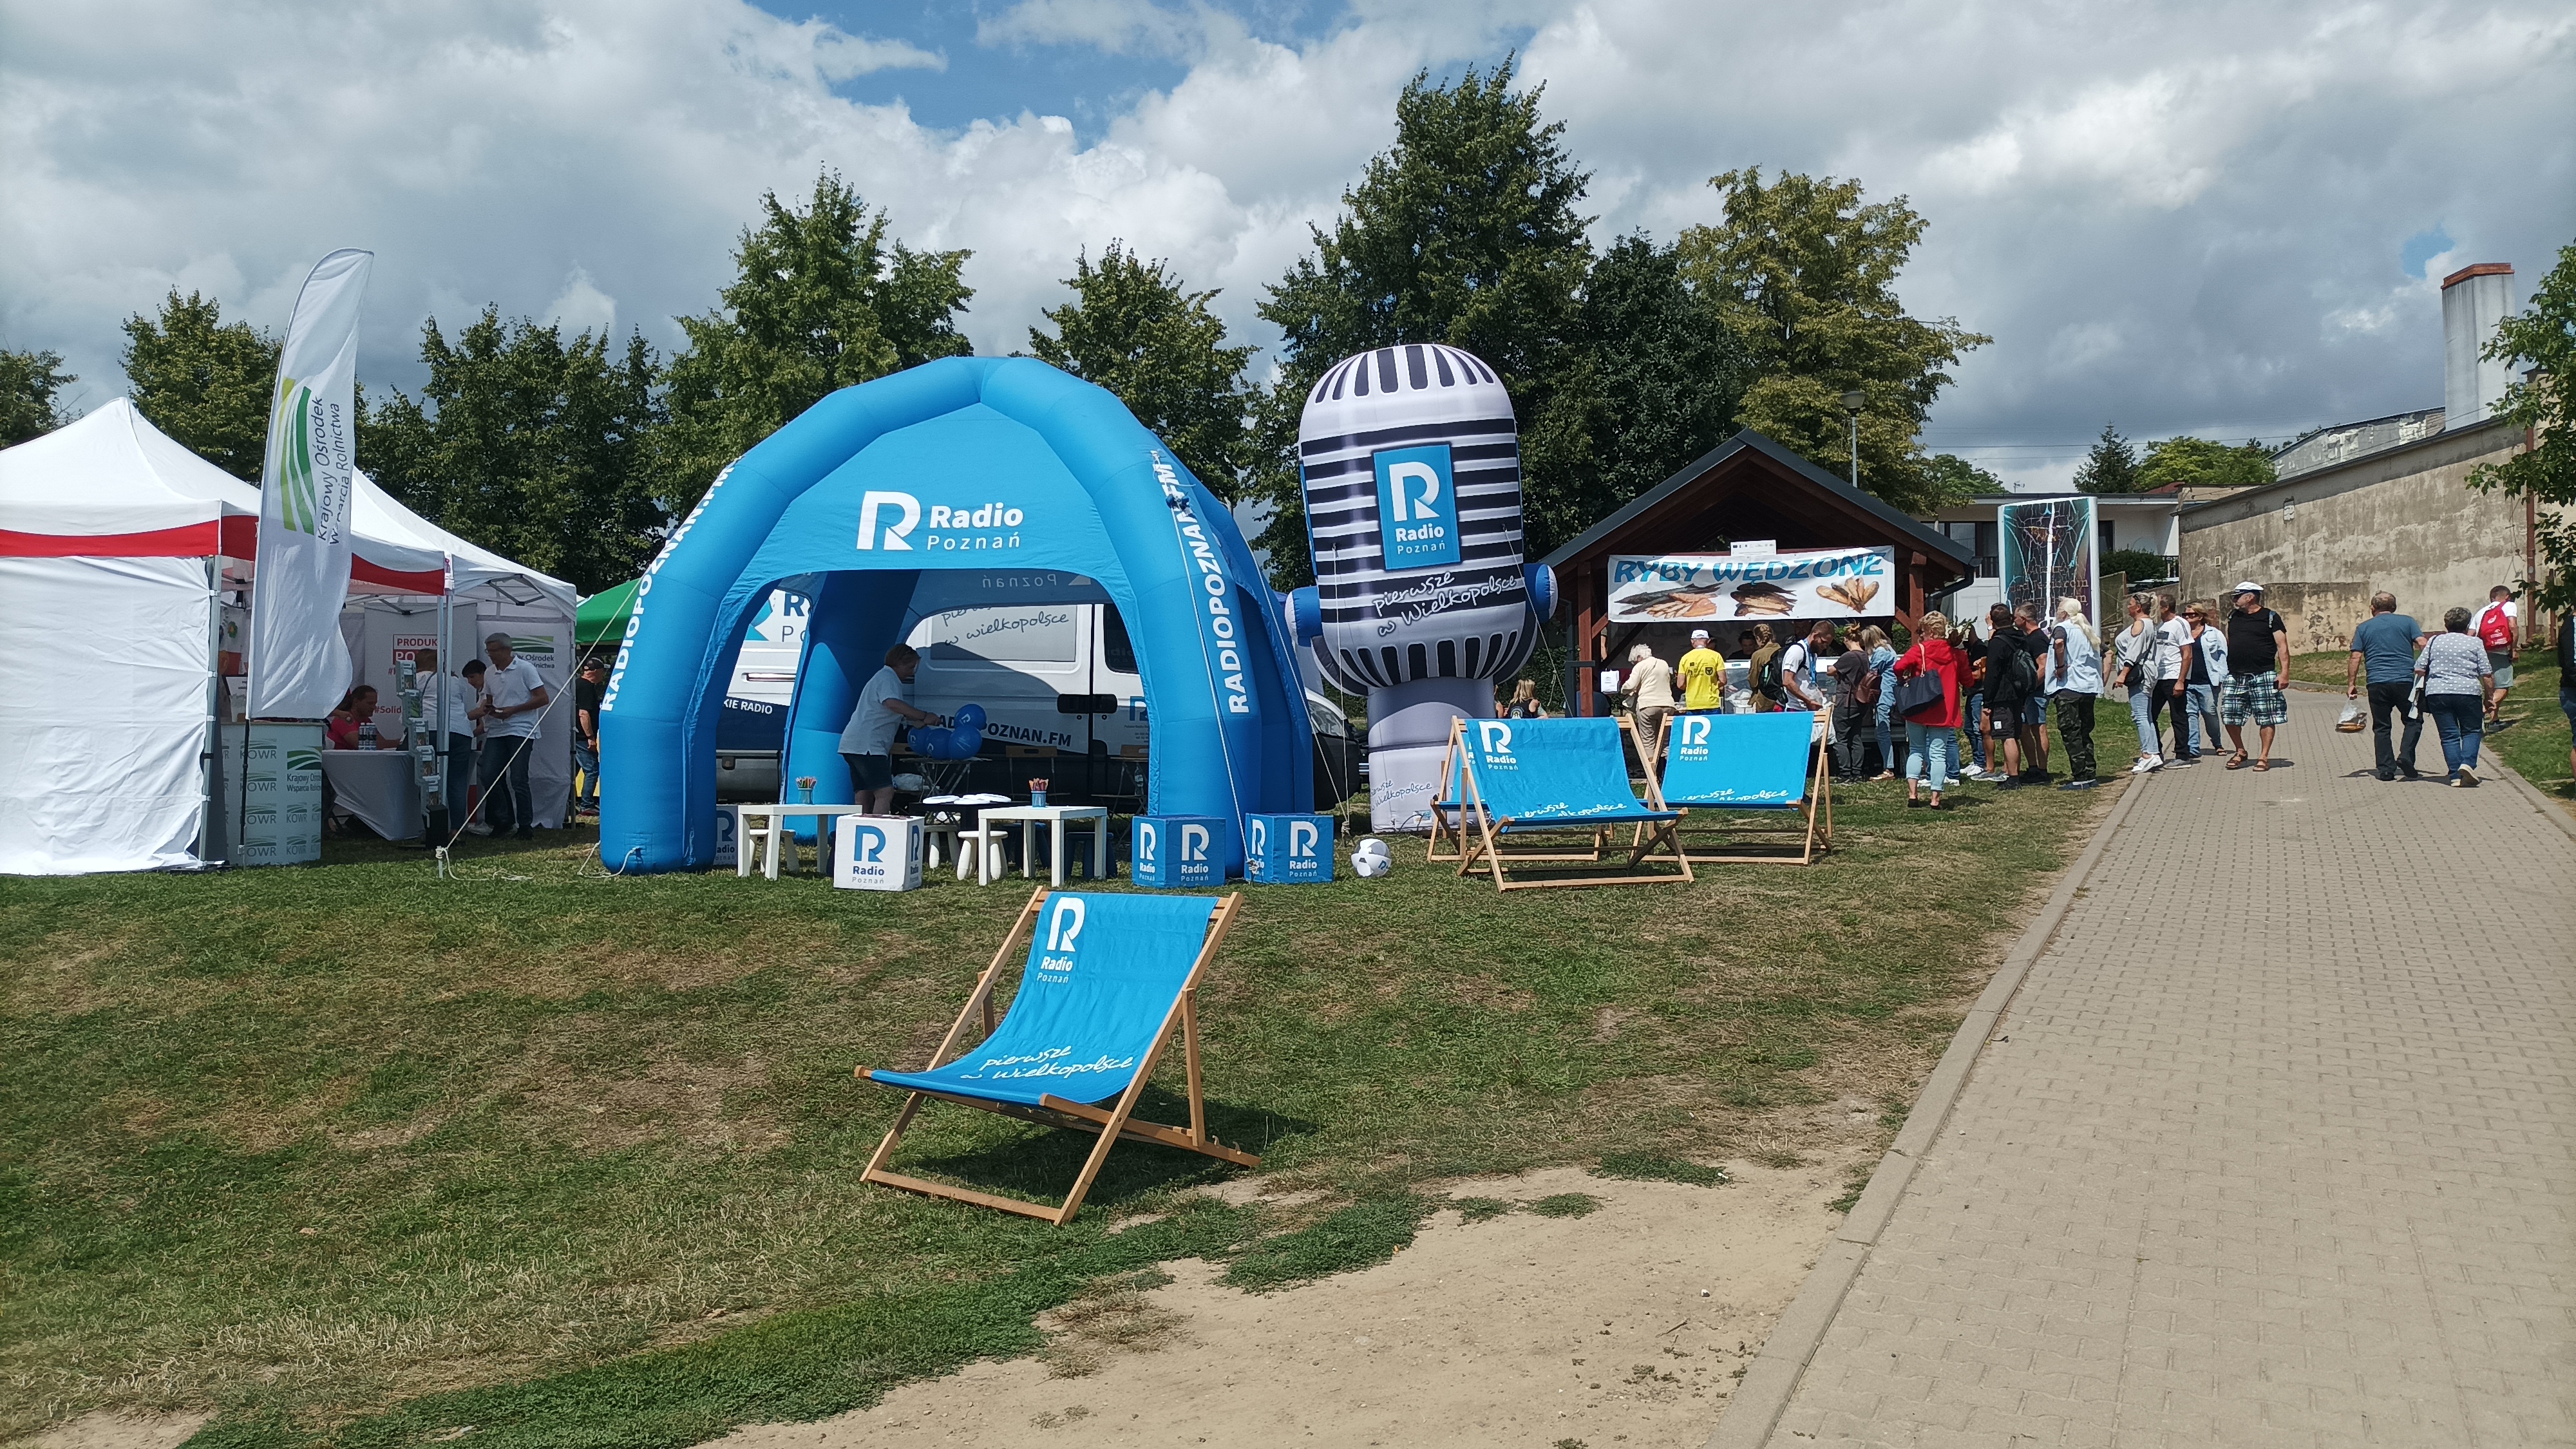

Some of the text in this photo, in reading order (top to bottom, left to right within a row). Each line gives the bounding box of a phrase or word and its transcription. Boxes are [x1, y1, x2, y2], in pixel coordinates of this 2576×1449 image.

[310, 395, 338, 541] Krajowy Ośrodek
[329, 403, 350, 545] Warcia Rolnictwa
[929, 502, 1024, 529] Radio
[1395, 523, 1444, 542] Radio
[927, 532, 1020, 551] Poznań
[1397, 540, 1446, 555] Poznań
[1614, 552, 1887, 586] RYBY WĘDZONE
[1373, 571, 1455, 617] pierwsze
[945, 635, 960, 646] w
[966, 611, 1070, 640] wielkopolsce
[1378, 621, 1396, 636] w
[741, 701, 773, 714] RADIO
[1680, 746, 1709, 755] Radio
[1486, 755, 1517, 764] Radio
[246, 846, 277, 857] OWR
[716, 844, 735, 853] adio
[852, 866, 885, 876] Radio
[1139, 862, 1155, 874] Radio
[1181, 864, 1209, 874] Radio
[1289, 860, 1318, 869] Radio
[1040, 956, 1074, 972] Radio
[1036, 972, 1069, 983] Poznań
[979, 1045, 1072, 1071] pierwsze
